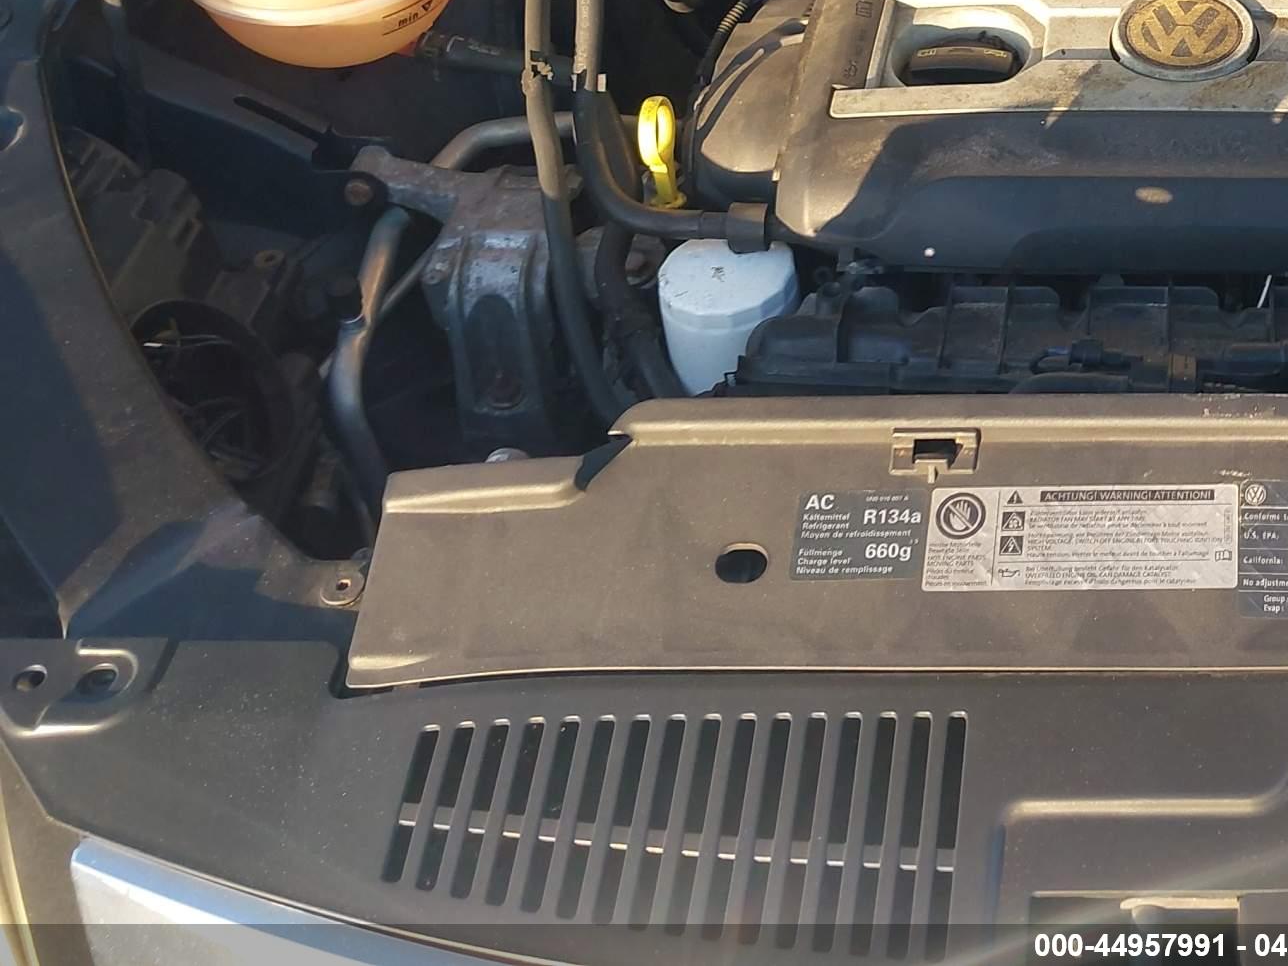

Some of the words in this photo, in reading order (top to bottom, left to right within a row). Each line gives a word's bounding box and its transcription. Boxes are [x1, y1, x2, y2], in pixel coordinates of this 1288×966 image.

[398, 12, 419, 27] min
[1044, 491, 1097, 502] ACHTUNG!
[1100, 491, 1151, 501] WARNING!
[1153, 490, 1212, 500] ATTENTION!
[805, 494, 835, 510] AC
[863, 509, 922, 524] R134a
[1244, 513, 1280, 521] Conforms
[802, 522, 850, 531] Refrigerant
[801, 531, 830, 540] Moyen
[832, 530, 843, 538] de
[845, 530, 912, 539] refroidissement
[864, 542, 912, 562] 660g
[797, 558, 828, 567] Charge
[829, 557, 851, 565] level
[796, 567, 826, 575] Niveau
[828, 566, 839, 574] de
[841, 565, 893, 575] remplissage
[1264, 595, 1288, 604] Group:
[1264, 604, 1285, 614] Evap:
